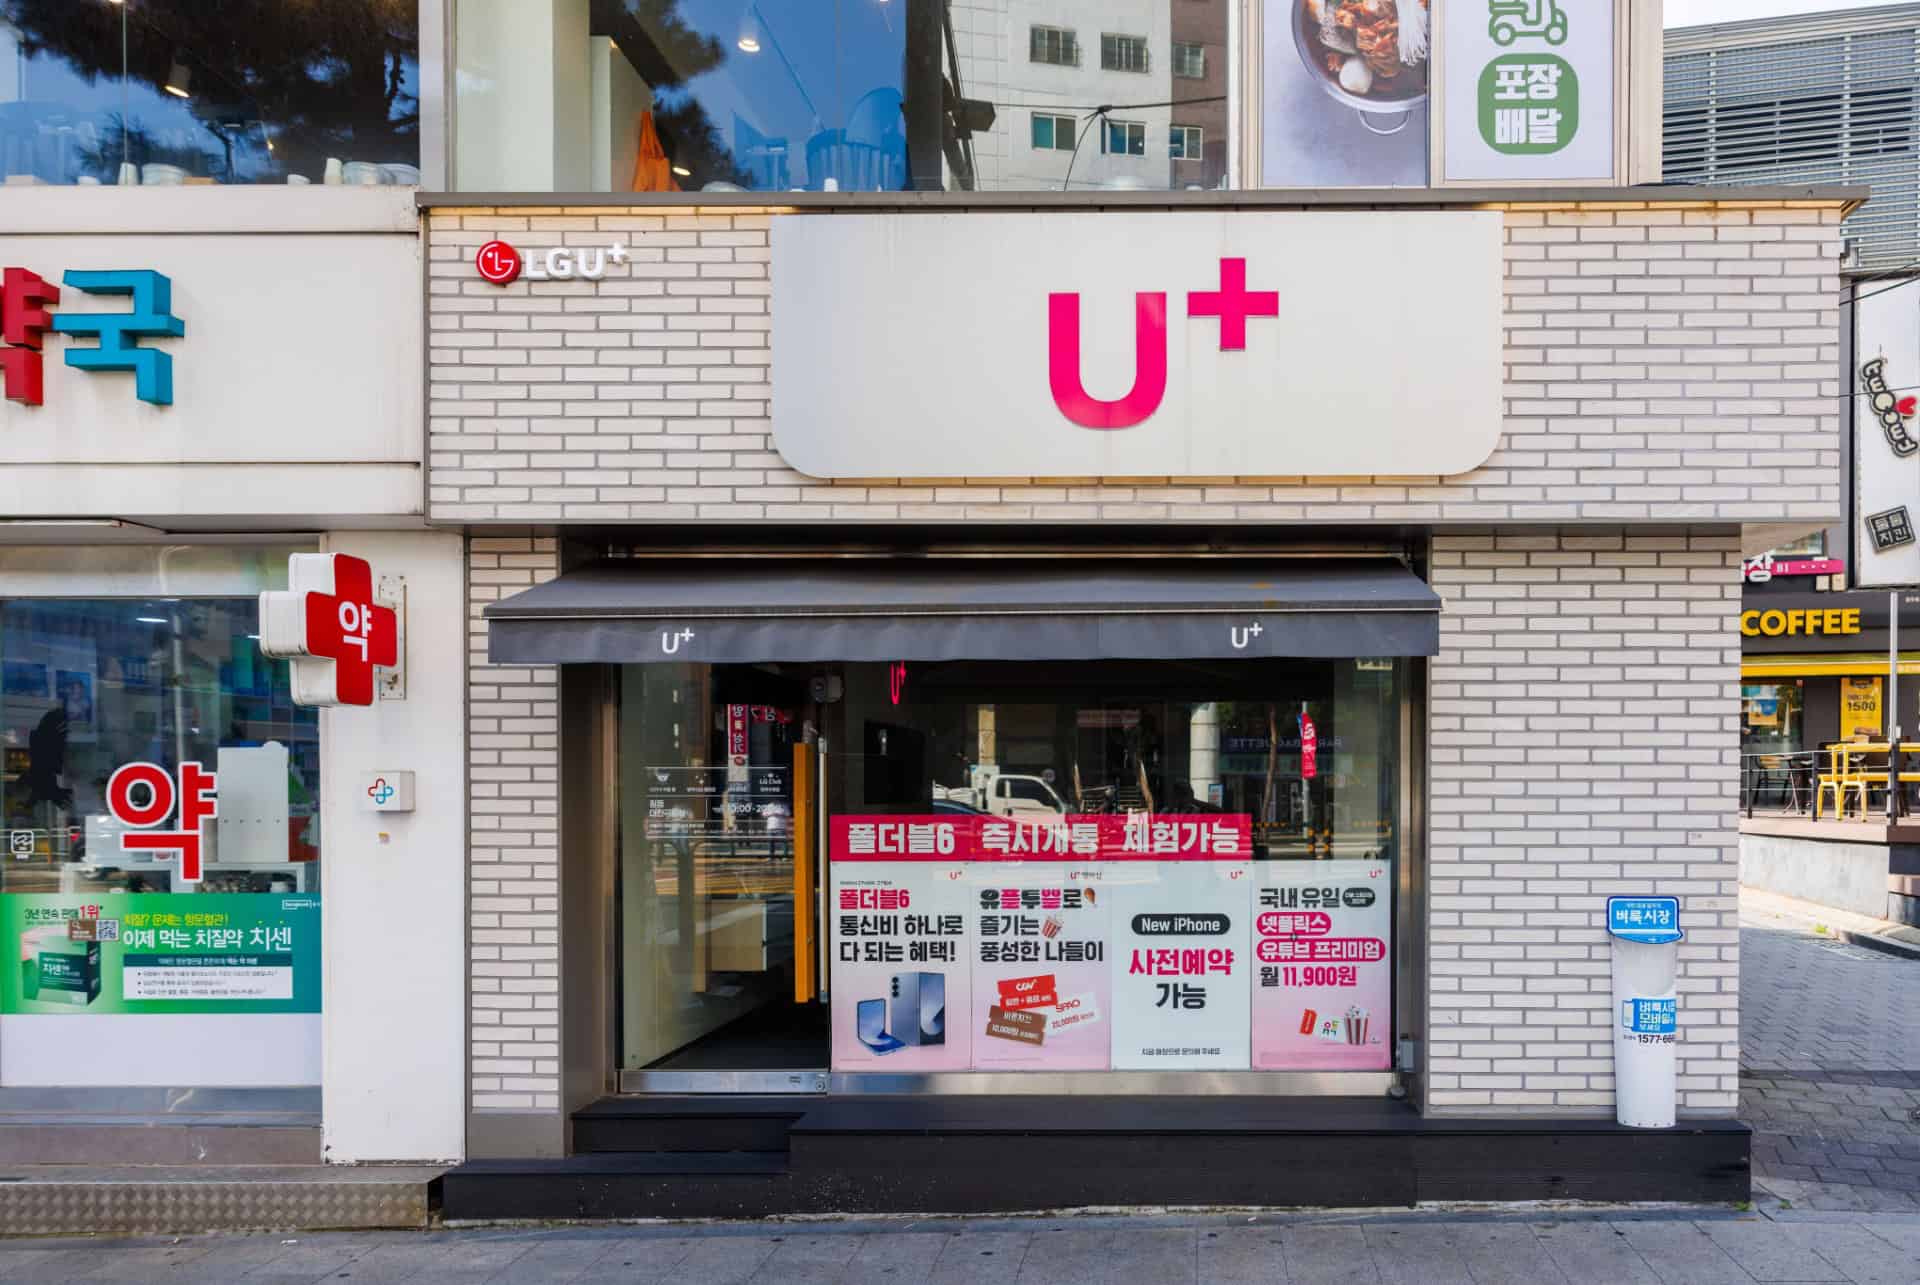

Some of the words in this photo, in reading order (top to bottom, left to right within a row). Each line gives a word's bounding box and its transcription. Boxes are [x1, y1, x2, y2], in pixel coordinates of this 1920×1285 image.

[1494, 63, 1562, 100] 포장
[1495, 107, 1562, 144] 배달
[1049, 257, 1279, 430] U+
[338, 601, 372, 662] 약
[1741, 608, 1861, 636] COFFEE
[662, 627, 695, 654] U+
[1232, 622, 1263, 648] U+
[1847, 701, 1876, 712] 1500
[107, 762, 218, 882] 약
[848, 822, 954, 854] 폴더블6
[983, 822, 1098, 854] 즉시개통
[1122, 822, 1240, 853] 체험가능
[840, 889, 910, 910] 폴더블6
[1260, 888, 1298, 908] 국내
[1301, 887, 1340, 908] 유일
[840, 915, 898, 936] 통신비
[904, 914, 963, 936] 하나로
[980, 915, 1039, 936] 즐기는
[1141, 918, 1170, 932] New
[1174, 917, 1220, 932] iPhone
[1261, 915, 1327, 933] 넷플릭스
[123, 929, 156, 949] 이제
[159, 929, 192, 949] 먹는
[195, 929, 243, 949] 치질약
[249, 926, 292, 951] 치센
[1261, 941, 1311, 959] 유튜브
[1314, 941, 1380, 959] 프리미엄
[840, 942, 860, 962] 다
[864, 941, 904, 962] 되는
[909, 941, 956, 962] 혜택!
[980, 941, 1040, 962] 풍성한
[1045, 941, 1103, 962] 나들이
[1129, 949, 1234, 976] 사전예약
[1260, 966, 1279, 987] 월
[1283, 966, 1357, 987] 11,900원
[1155, 982, 1206, 1009] 가능
